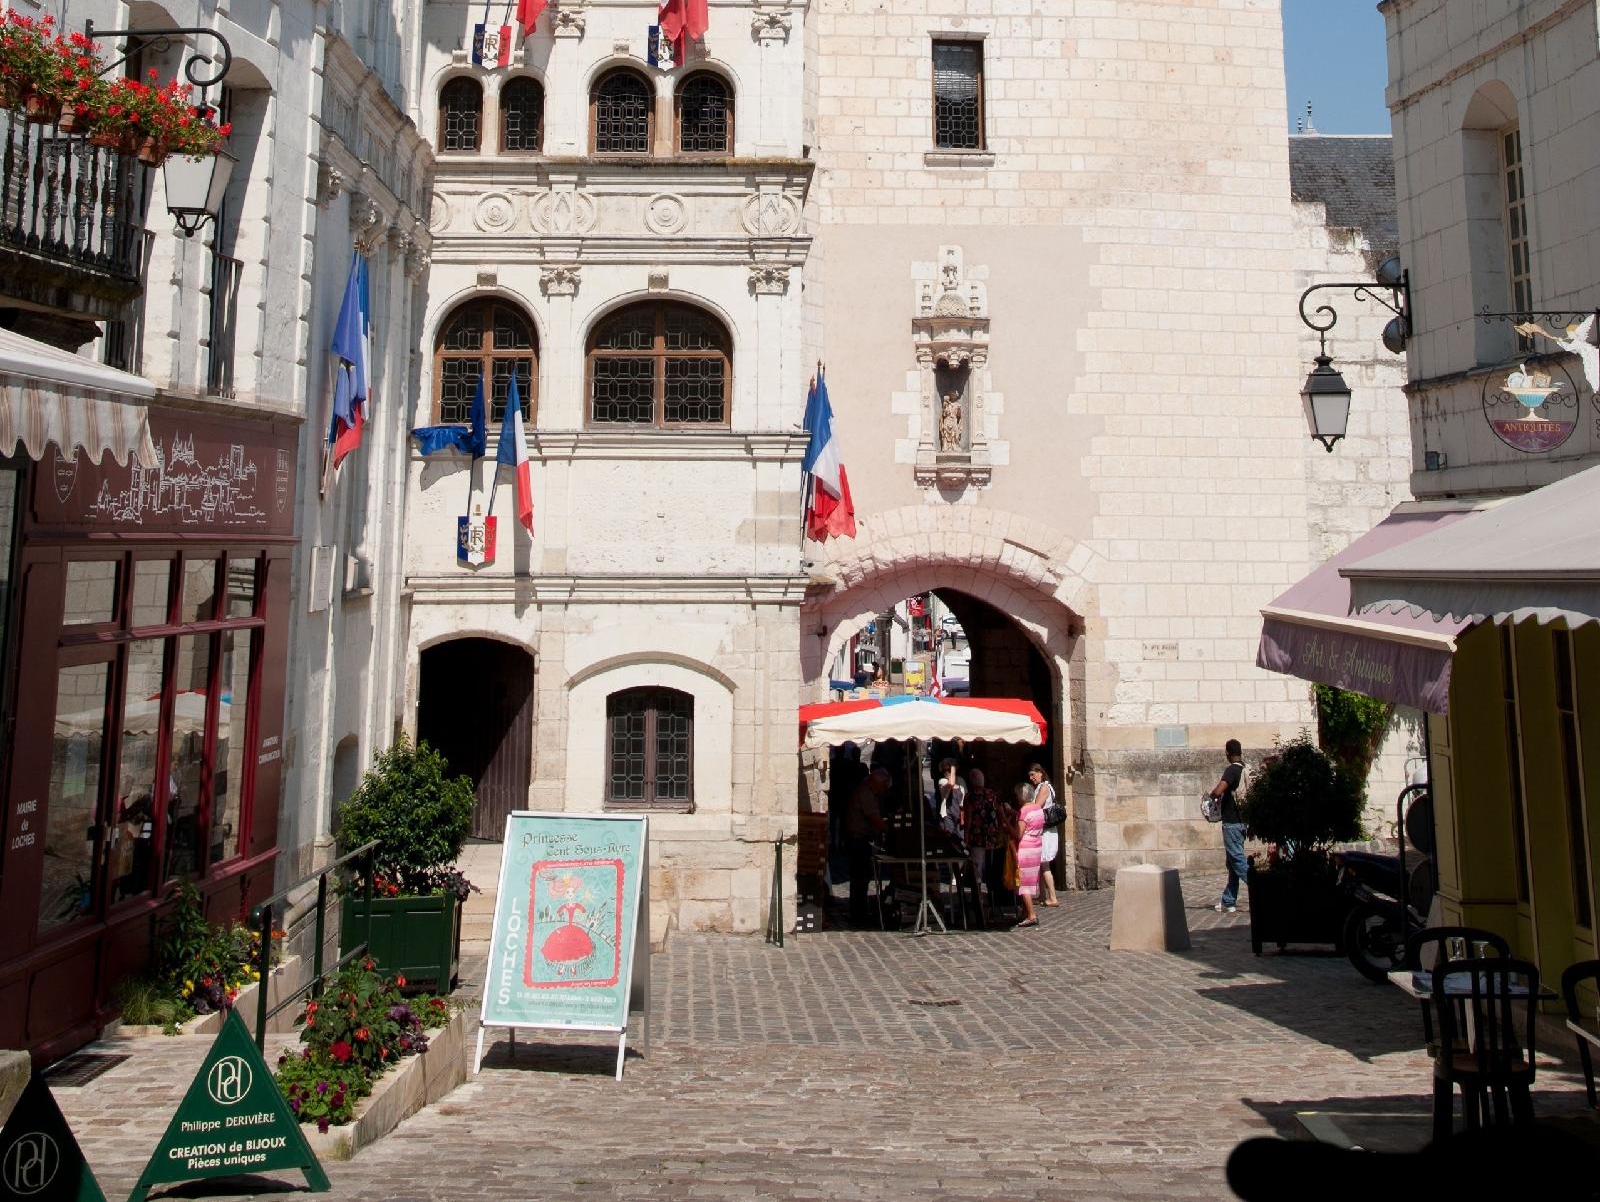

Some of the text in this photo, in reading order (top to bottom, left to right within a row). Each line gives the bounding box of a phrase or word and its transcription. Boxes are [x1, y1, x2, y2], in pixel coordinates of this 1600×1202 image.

[1302, 633, 1393, 693] Art & Antiques
[16, 799, 37, 815] MAIRIE
[20, 818, 29, 831] de
[11, 832, 36, 850] LOCHES
[523, 832, 578, 847] Princesse
[498, 897, 521, 1005] LOCHES
[181, 1111, 276, 1132] Philippe DERIVIÈRE
[168, 1136, 287, 1159] CREATION de BIJOUX
[187, 1152, 267, 1170] Pièces uniques
